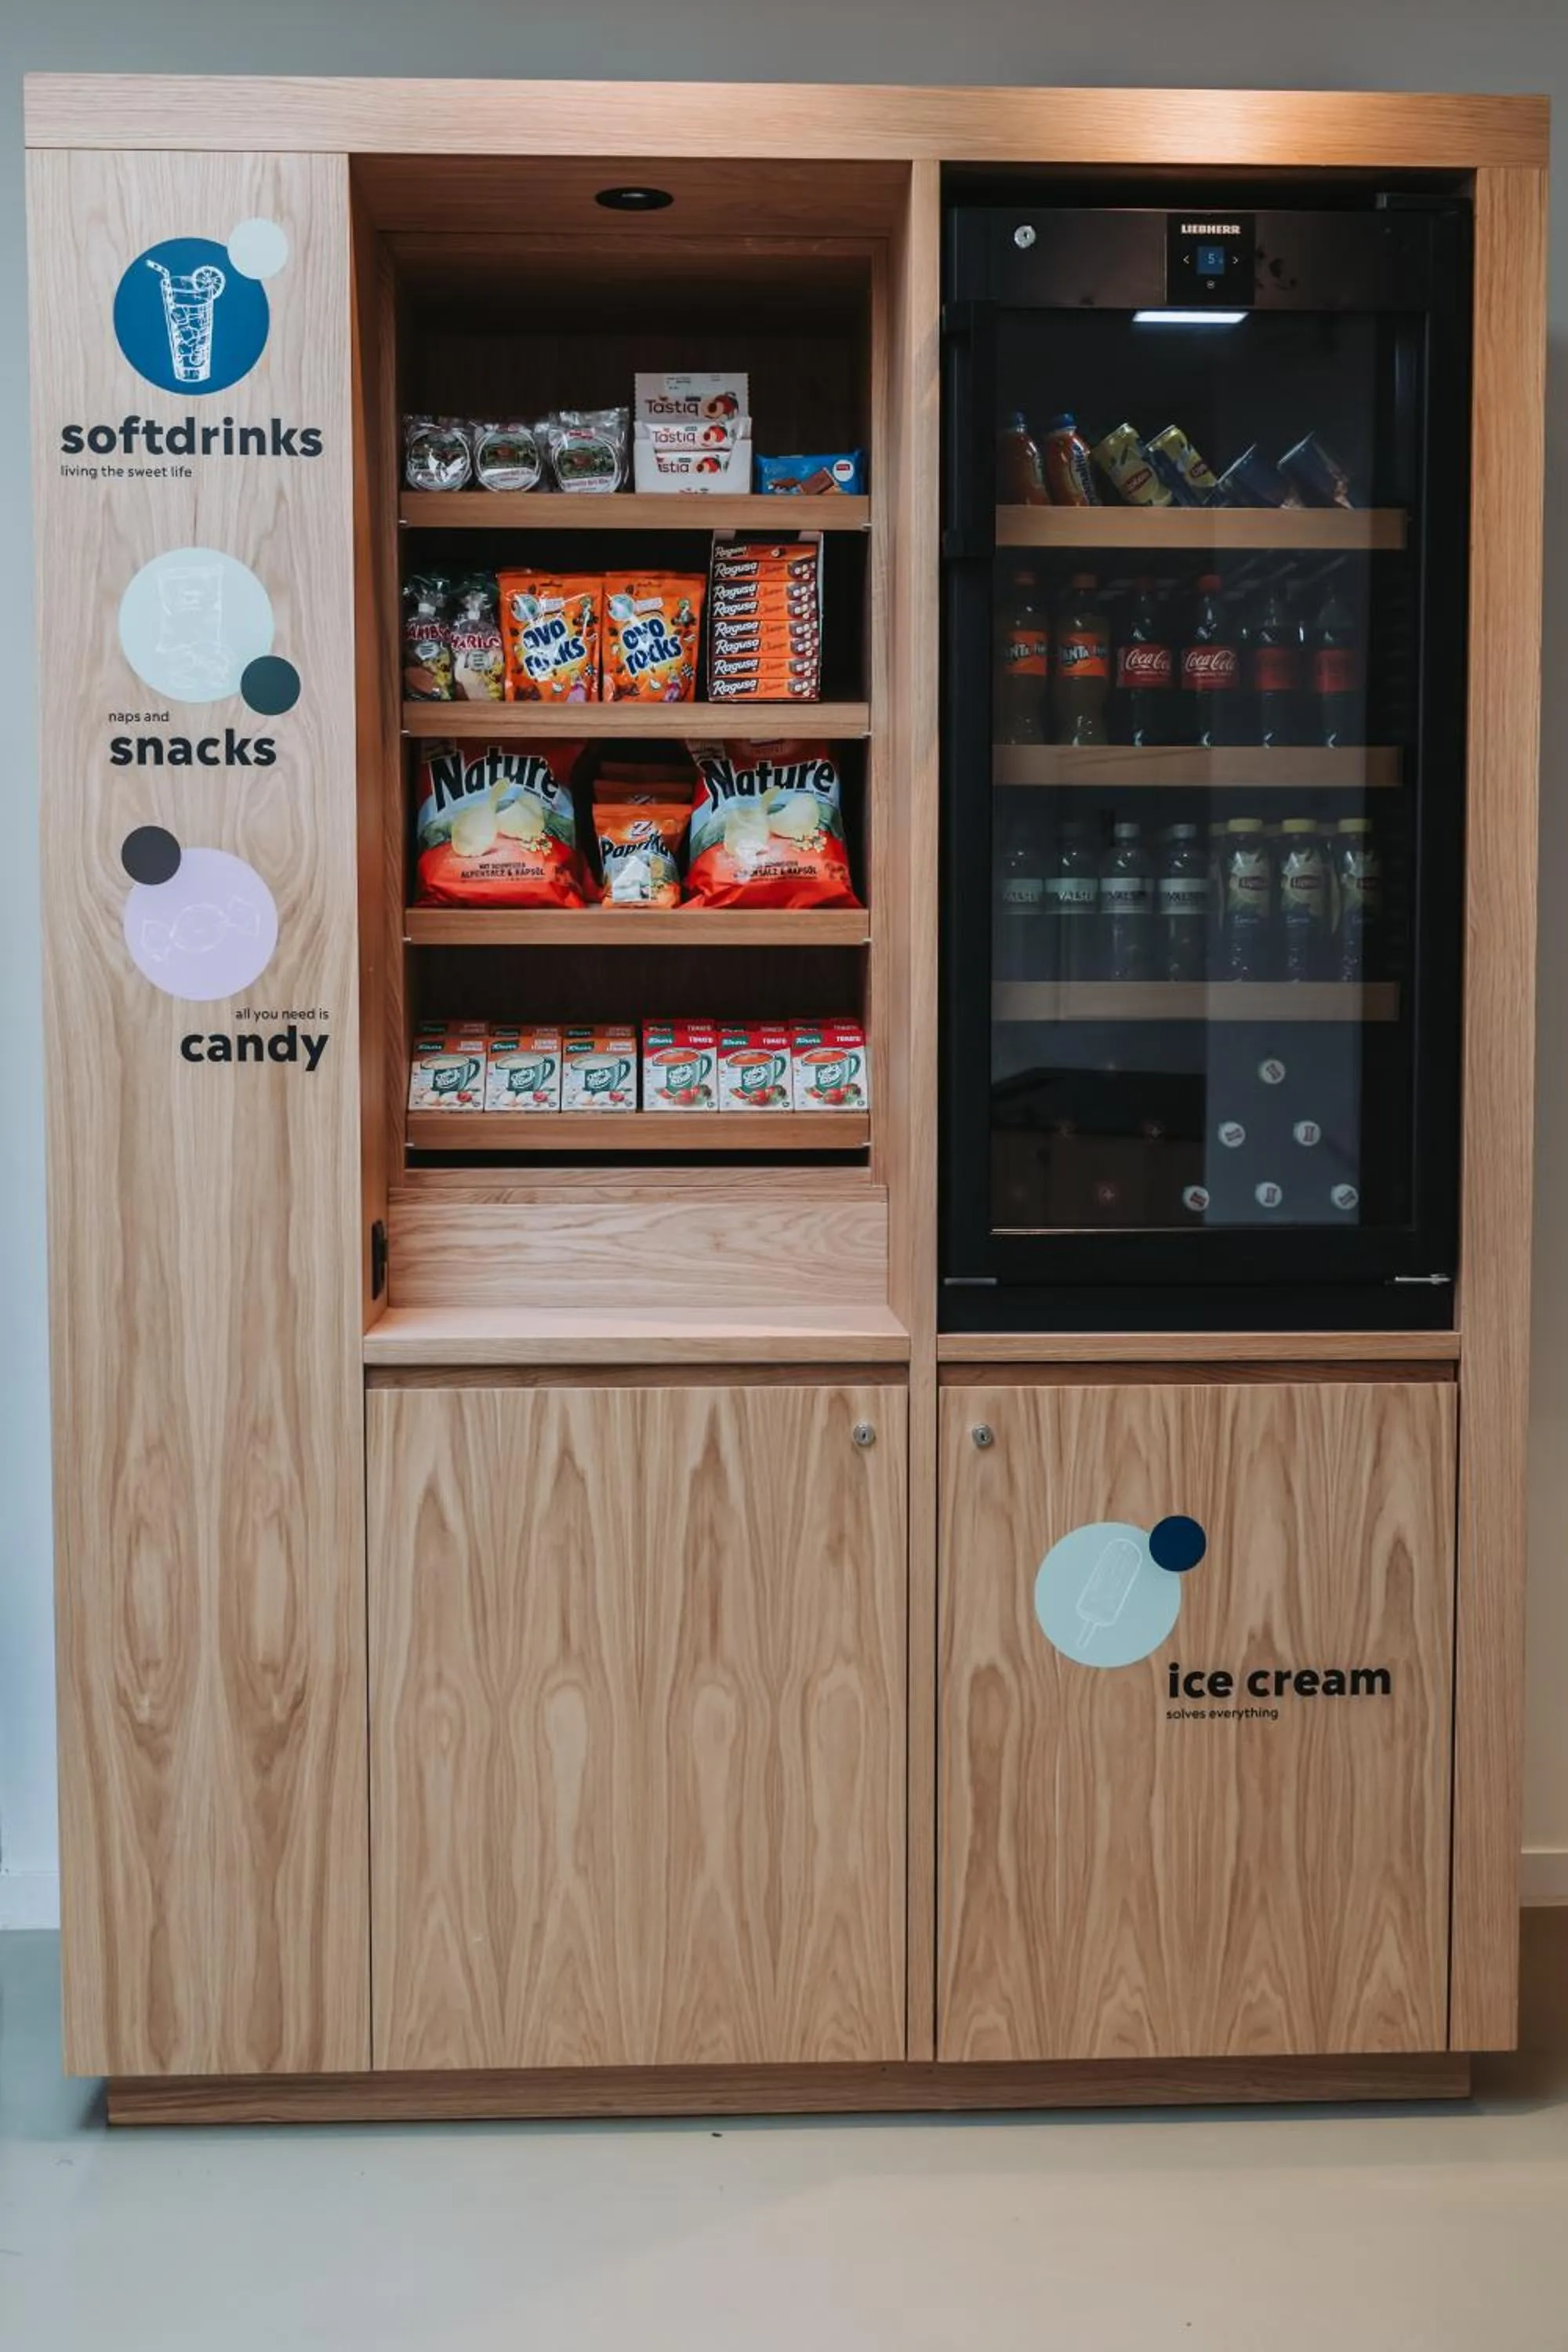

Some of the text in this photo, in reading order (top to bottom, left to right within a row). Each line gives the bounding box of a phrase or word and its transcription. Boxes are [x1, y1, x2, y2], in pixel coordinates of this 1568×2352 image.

[1181, 224, 1241, 234] LIEBHERR
[60, 416, 323, 457] softdrinks
[60, 465, 193, 480] living the sweet life
[714, 561, 757, 578] Ragusa
[713, 583, 757, 601] Ragusa
[713, 601, 757, 618] Ragusa
[714, 621, 758, 637] Ragusa
[715, 639, 760, 655] Ragusa
[714, 659, 758, 675] Ragusa
[713, 679, 757, 696] Ragusa
[108, 710, 169, 724] naps and
[110, 728, 276, 766] snacks
[430, 746, 559, 814] Nature
[698, 759, 836, 813] Nature
[235, 1008, 329, 1022] all you need is
[180, 1025, 329, 1071] candy
[1168, 1663, 1392, 1698] ice cream
[1166, 1707, 1279, 1722] solves everything
